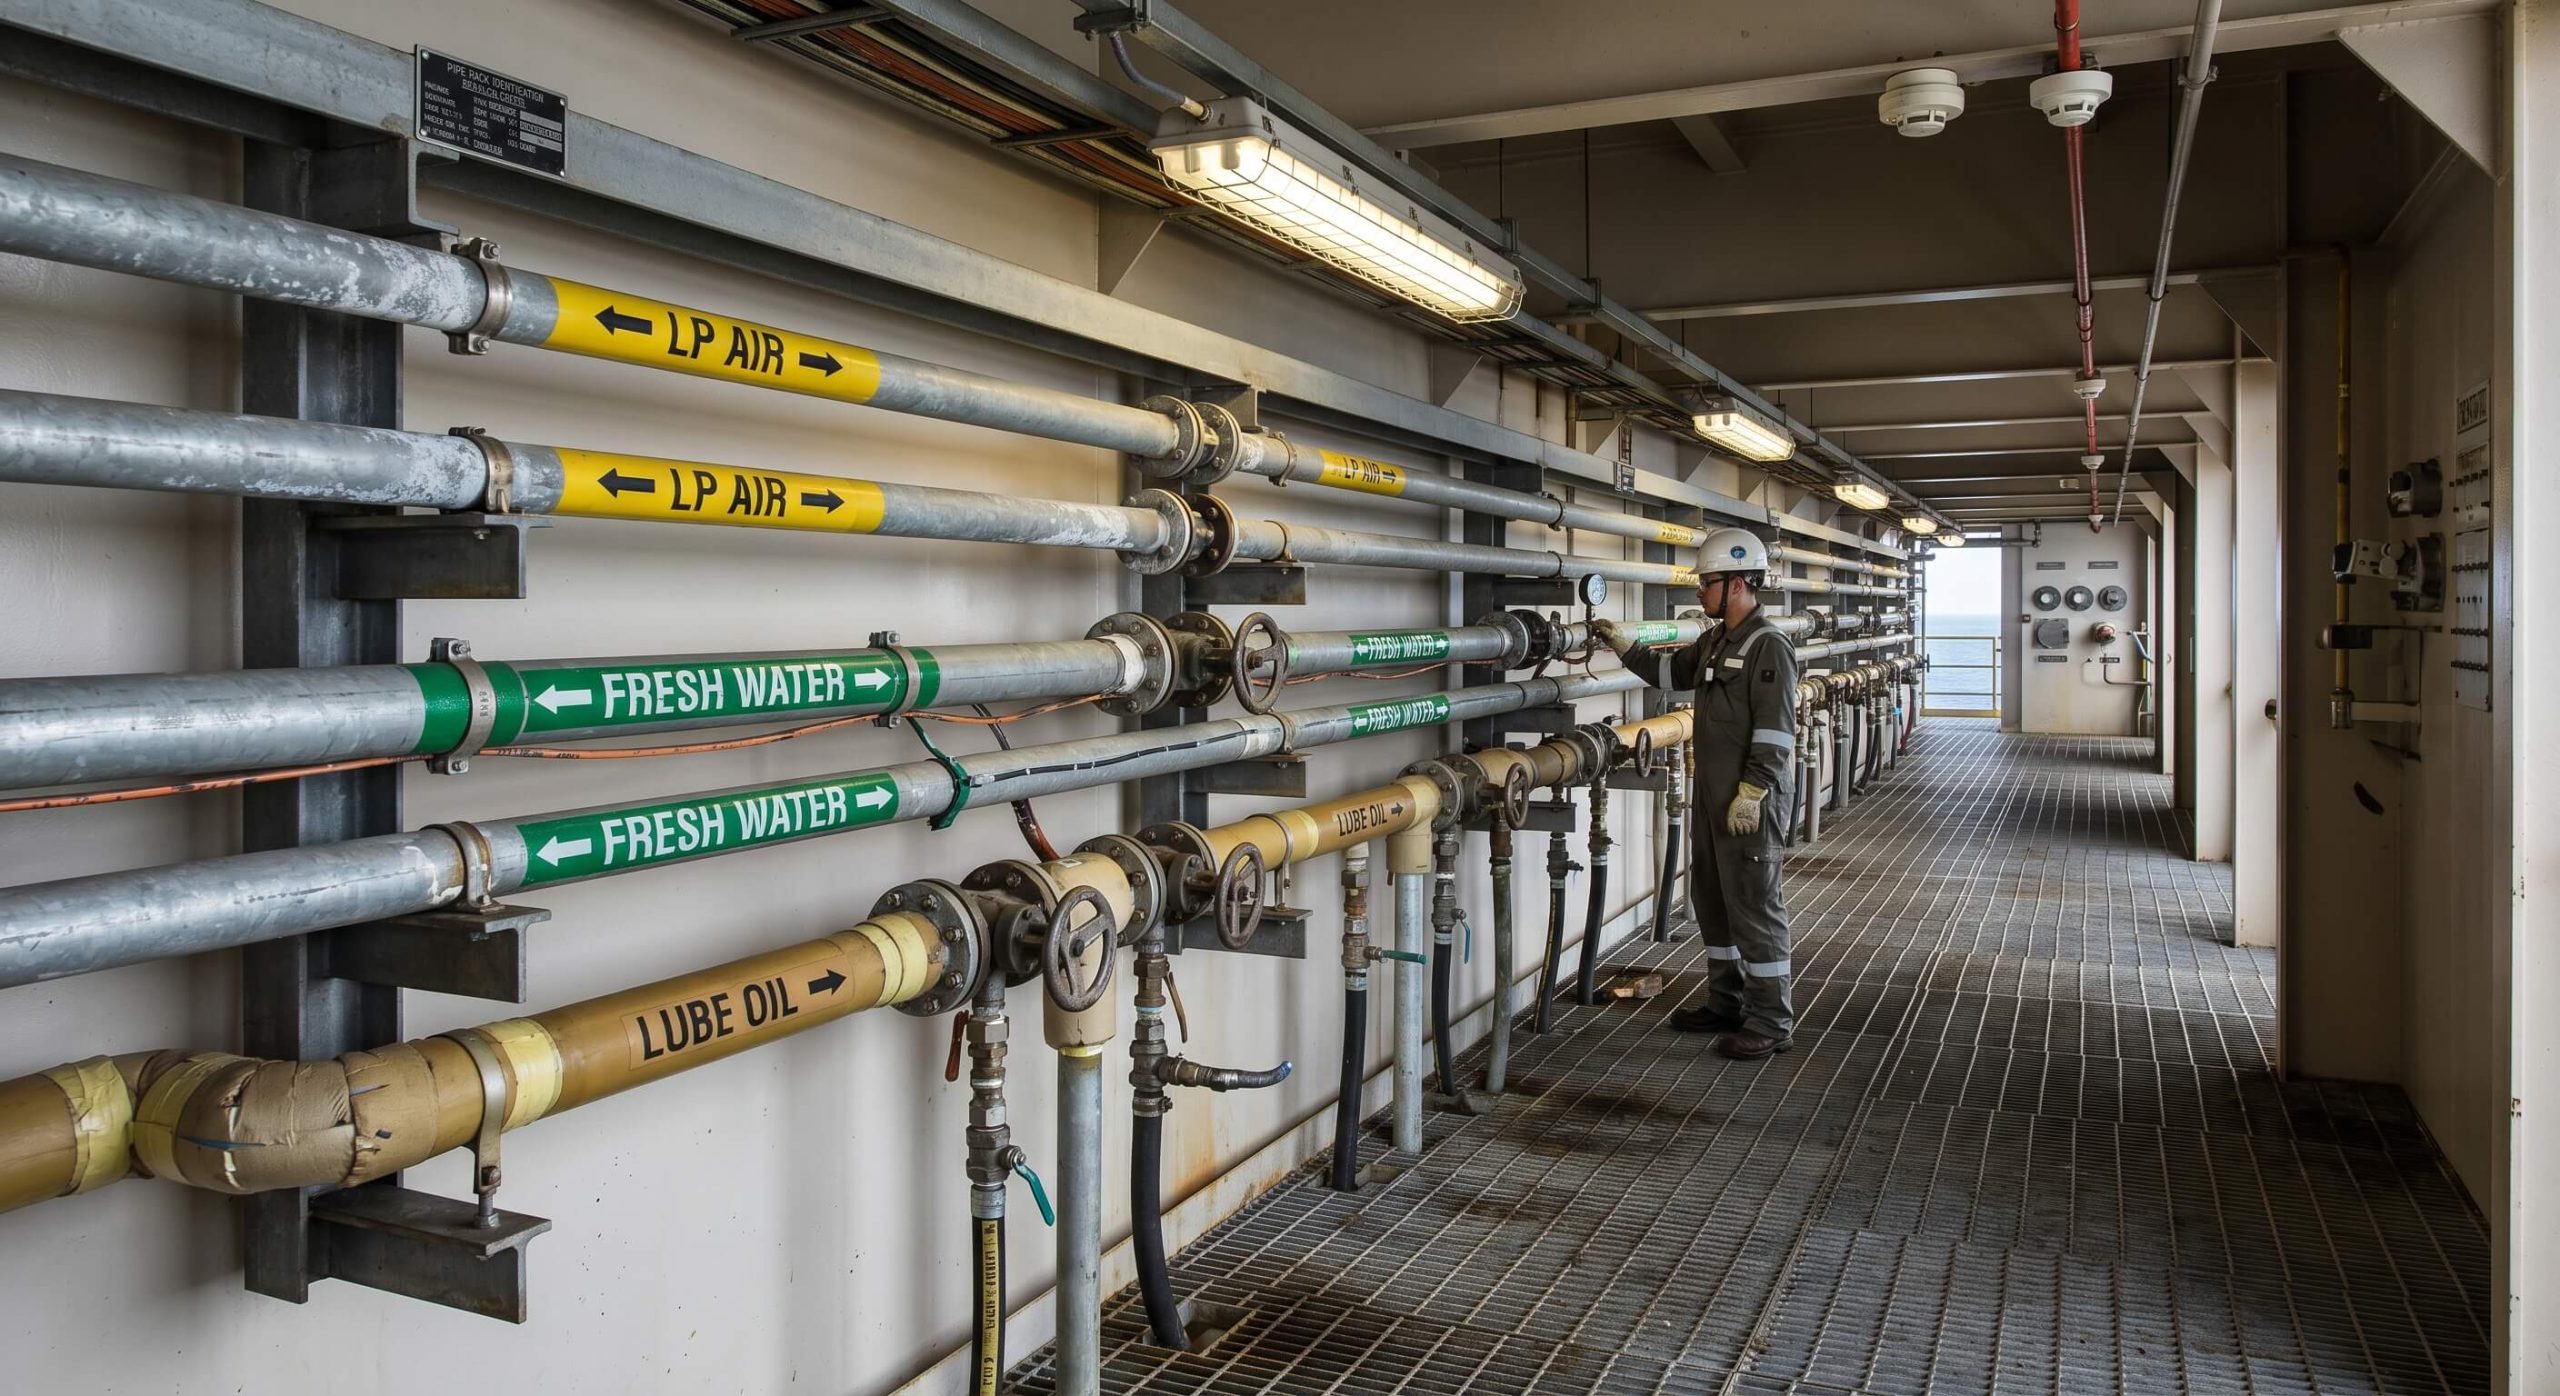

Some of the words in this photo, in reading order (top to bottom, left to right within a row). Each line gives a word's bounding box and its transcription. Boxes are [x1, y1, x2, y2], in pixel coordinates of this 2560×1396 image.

[447, 62, 466, 77] PIPE
[468, 69, 490, 85] RACK
[667, 311, 715, 359] LP
[724, 326, 784, 376] AIR
[1343, 457, 1359, 480] LP
[1361, 461, 1381, 484] AIR
[669, 468, 718, 512] LP
[727, 475, 787, 517] AIR
[1401, 635, 1435, 658] WATER
[600, 668, 724, 719] FRESH
[733, 663, 846, 708] WATER
[1366, 705, 1401, 732] FRESH
[1401, 701, 1435, 726] WATER
[600, 804, 725, 865] FRESH
[733, 786, 848, 840] WATER
[1337, 808, 1367, 837] LUBE
[1370, 803, 1387, 828] OIL
[637, 993, 734, 1061] LUBE
[743, 977, 798, 1027] OIL
